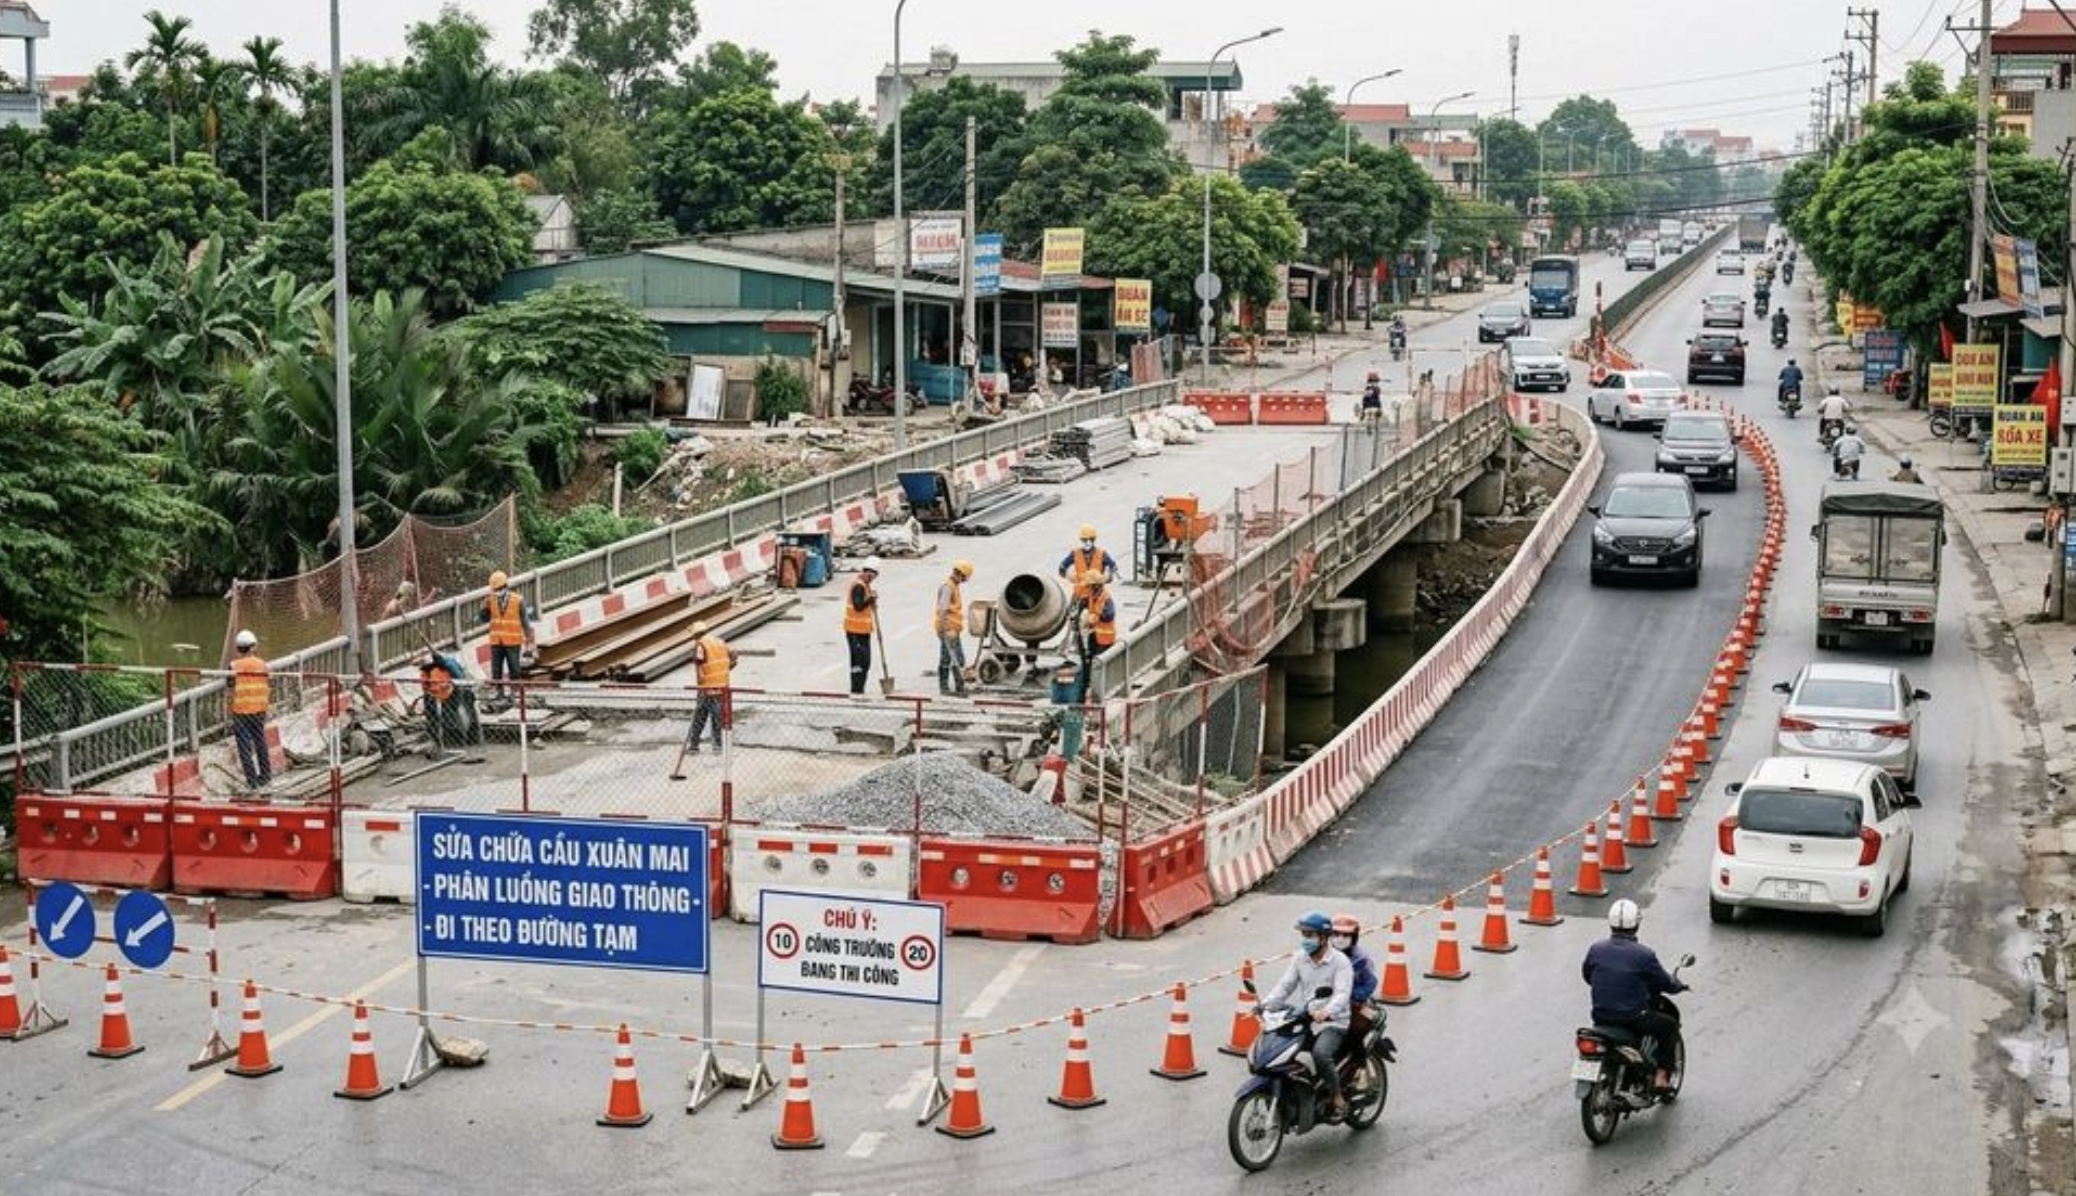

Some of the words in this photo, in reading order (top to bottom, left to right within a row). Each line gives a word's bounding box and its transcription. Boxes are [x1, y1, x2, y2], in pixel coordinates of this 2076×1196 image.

[2026, 428, 2043, 445] XE
[433, 824, 474, 860] SỬA
[480, 830, 534, 864] CHỮA
[586, 837, 643, 870] XUÂN
[649, 844, 689, 873] MAI
[434, 869, 490, 901] PHÂN
[568, 881, 616, 910] GIAO
[621, 880, 690, 914] THÔNG
[823, 907, 857, 930] CHÚ
[461, 916, 511, 944] THEO
[592, 922, 638, 957] TẠM
[774, 933, 792, 949] 10
[908, 945, 928, 962] 20
[840, 966, 861, 984] THI
[863, 965, 900, 987] CÔNG
